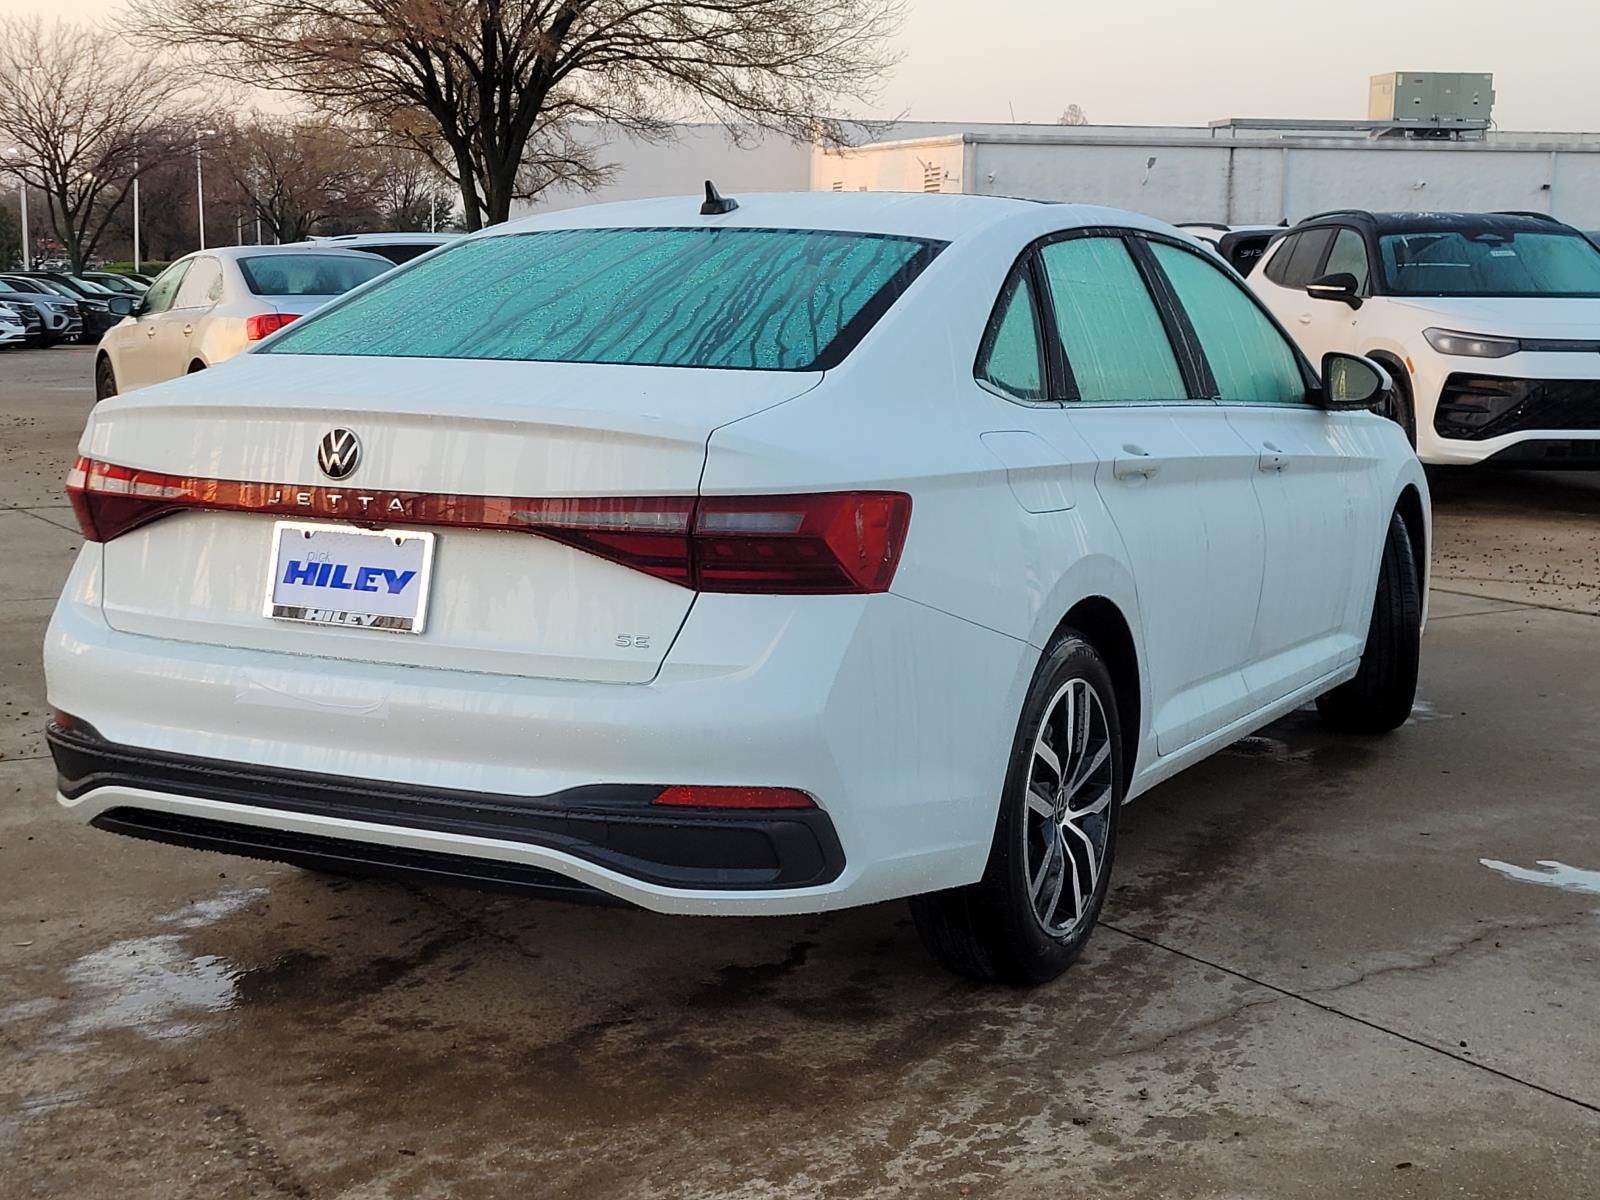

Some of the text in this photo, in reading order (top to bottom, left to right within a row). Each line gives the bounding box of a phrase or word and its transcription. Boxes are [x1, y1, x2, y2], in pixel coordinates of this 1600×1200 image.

[318, 428, 360, 479] VW
[268, 490, 404, 512] JETTA
[282, 560, 416, 594] HILEY
[304, 608, 378, 626] HILEY
[615, 635, 650, 648] SE
